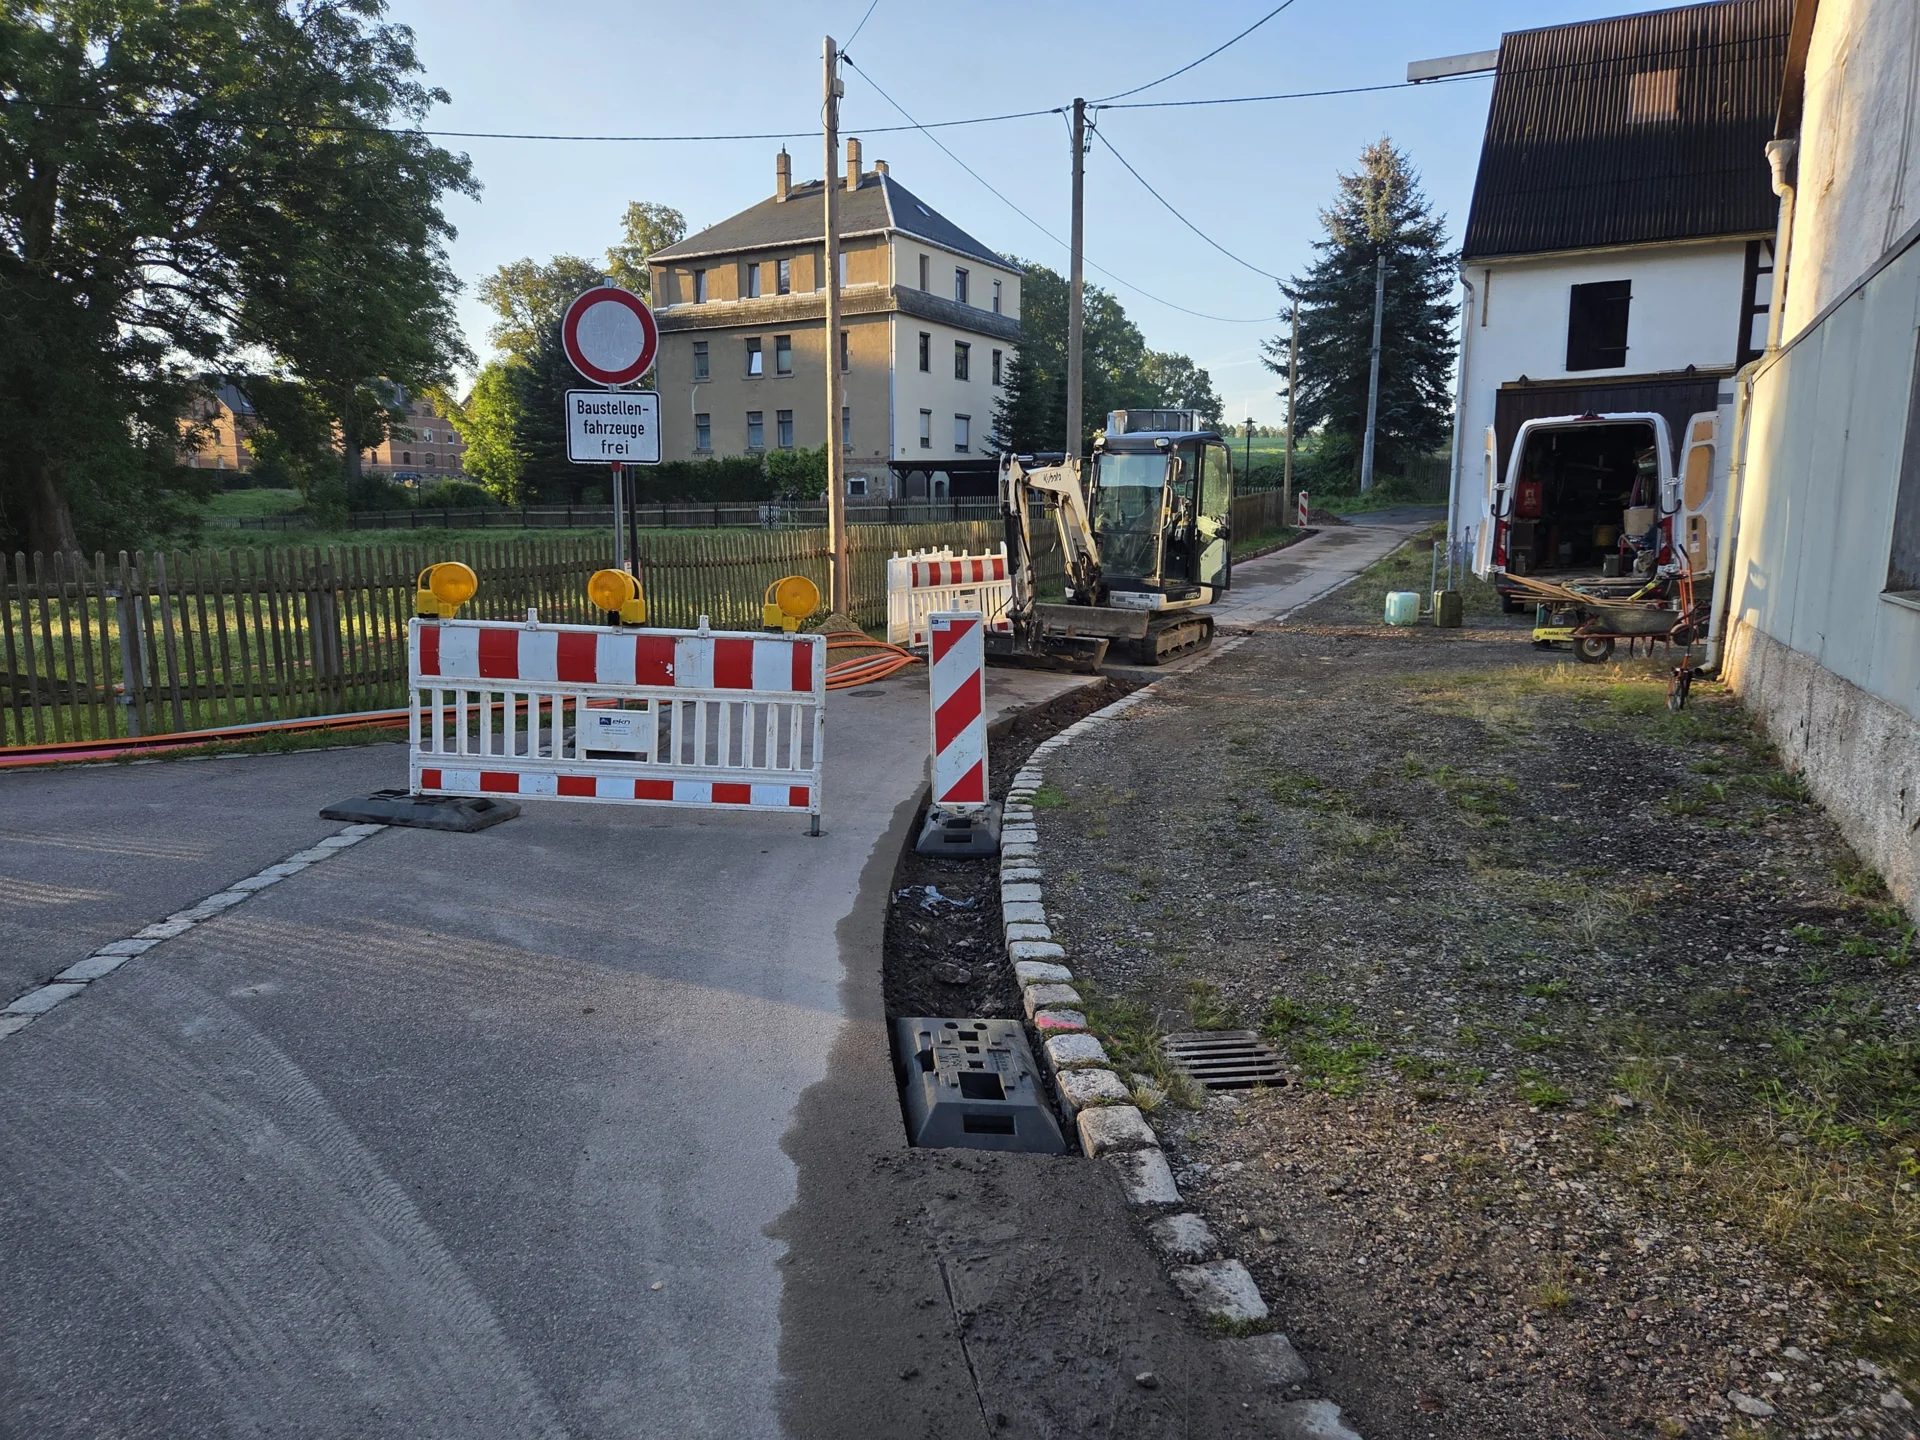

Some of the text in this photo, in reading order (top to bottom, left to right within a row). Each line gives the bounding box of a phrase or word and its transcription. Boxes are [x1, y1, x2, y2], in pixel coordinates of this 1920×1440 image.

[577, 399, 649, 416] Baustellen-
[583, 419, 645, 439] fahrzeuge
[601, 439, 629, 455] frei
